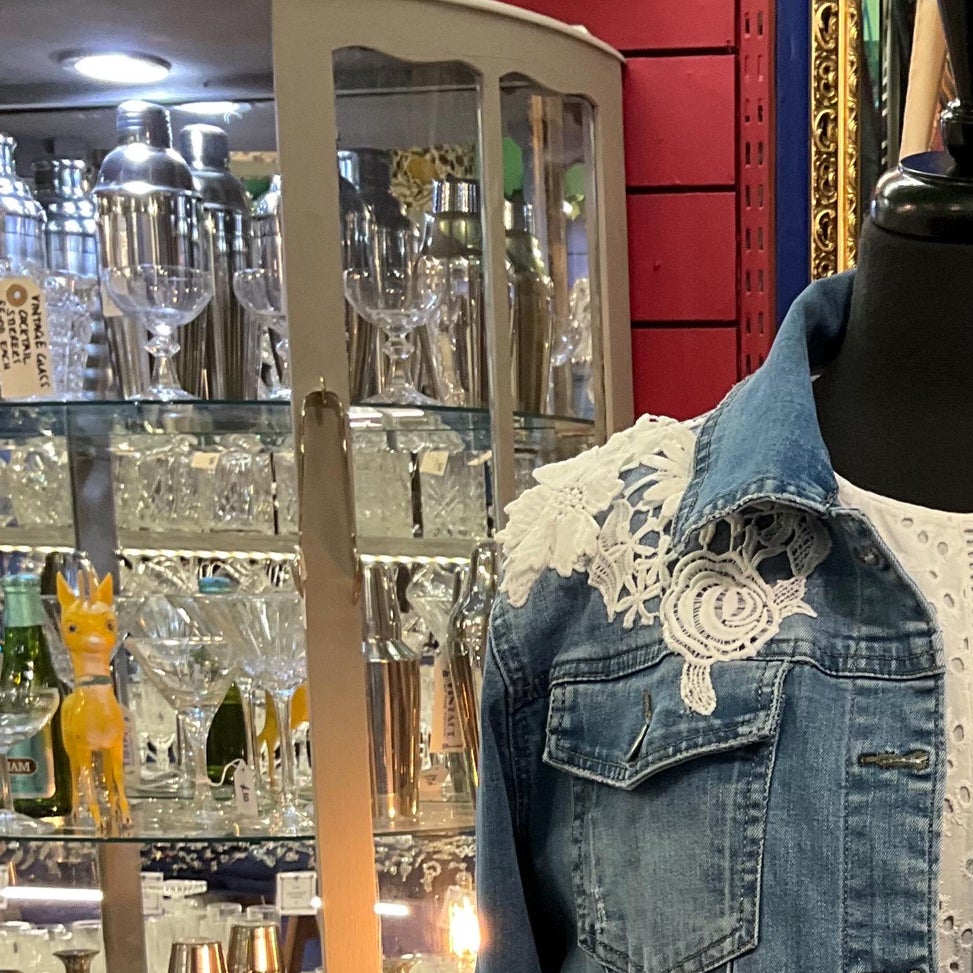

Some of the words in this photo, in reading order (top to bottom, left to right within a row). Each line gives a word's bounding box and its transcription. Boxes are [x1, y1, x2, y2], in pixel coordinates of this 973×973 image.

[18, 309, 31, 365] COCKTAIL
[31, 295, 47, 348] VINTAGE
[36, 353, 50, 388] GLASS
